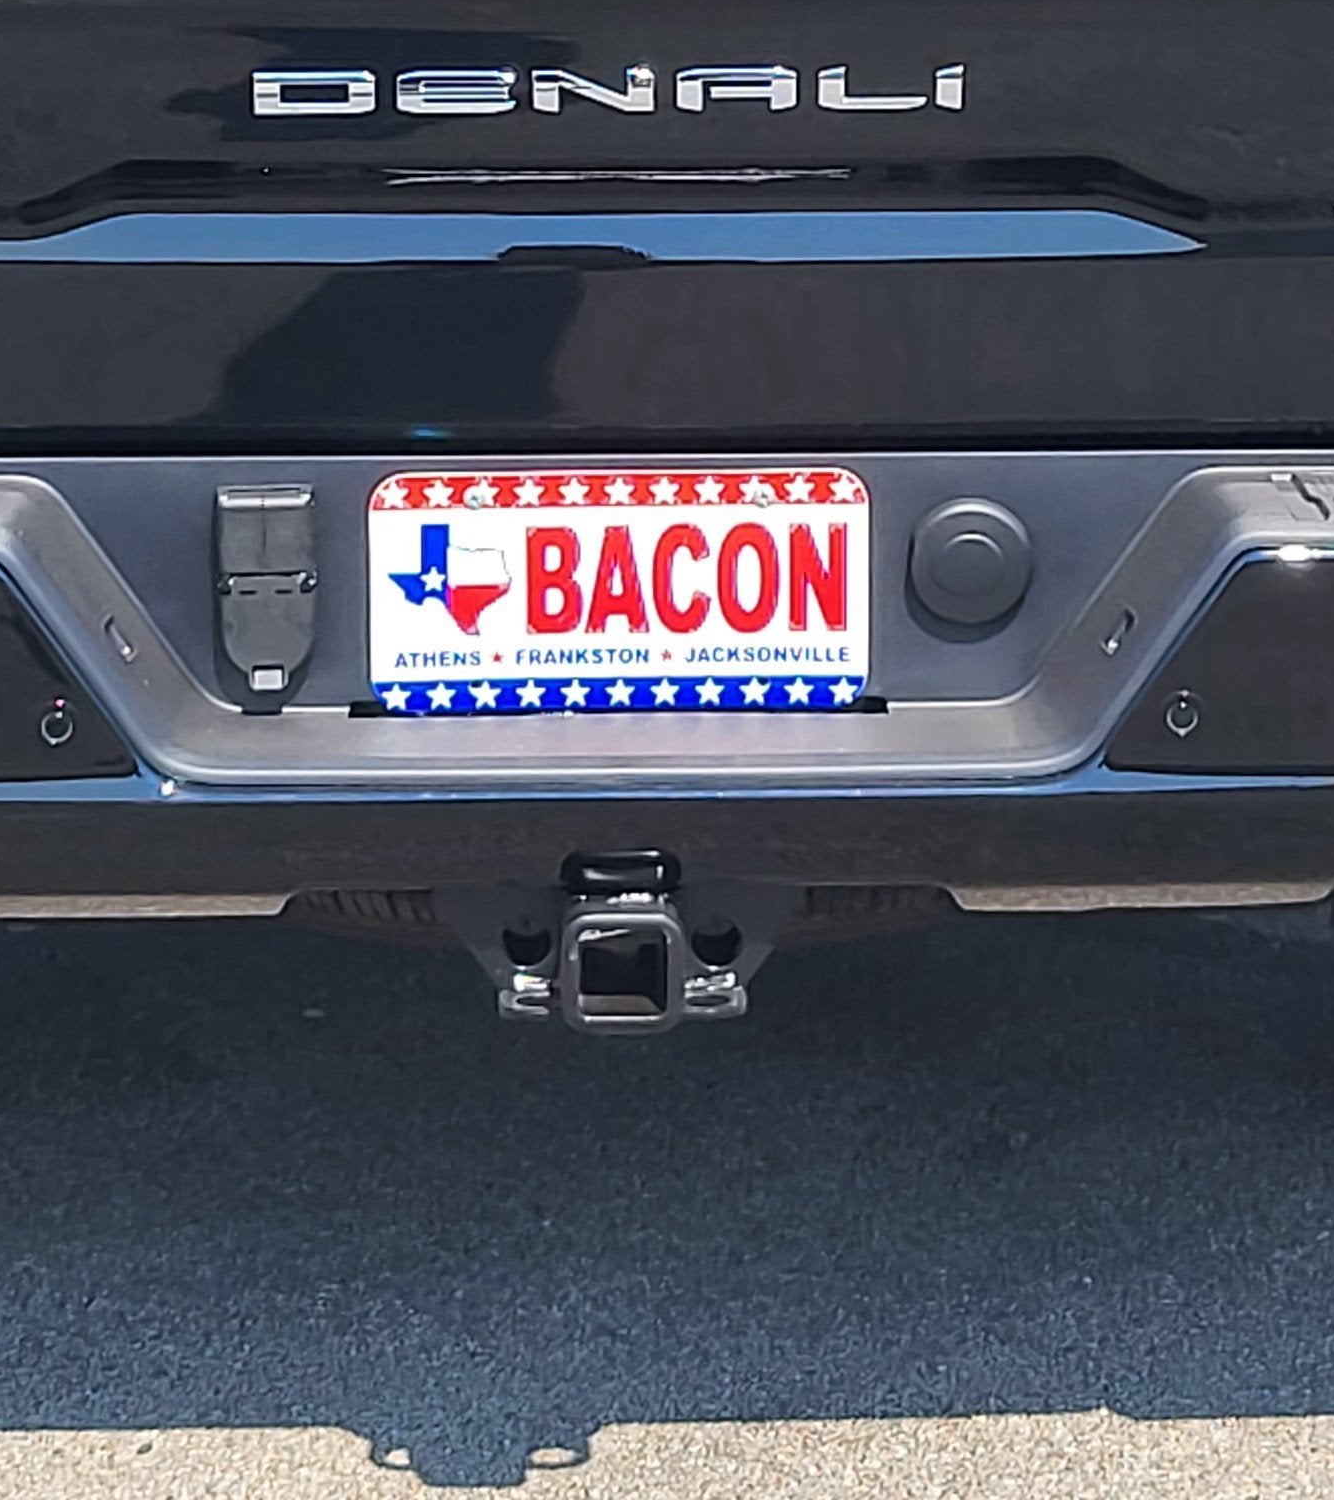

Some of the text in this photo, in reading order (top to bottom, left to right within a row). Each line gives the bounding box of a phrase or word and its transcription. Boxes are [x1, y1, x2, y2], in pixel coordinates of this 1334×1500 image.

[251, 62, 967, 116] DENALI
[525, 522, 849, 636] BACON
[394, 645, 851, 669] ATHENS FRANKSTON JACKSONVILLE
